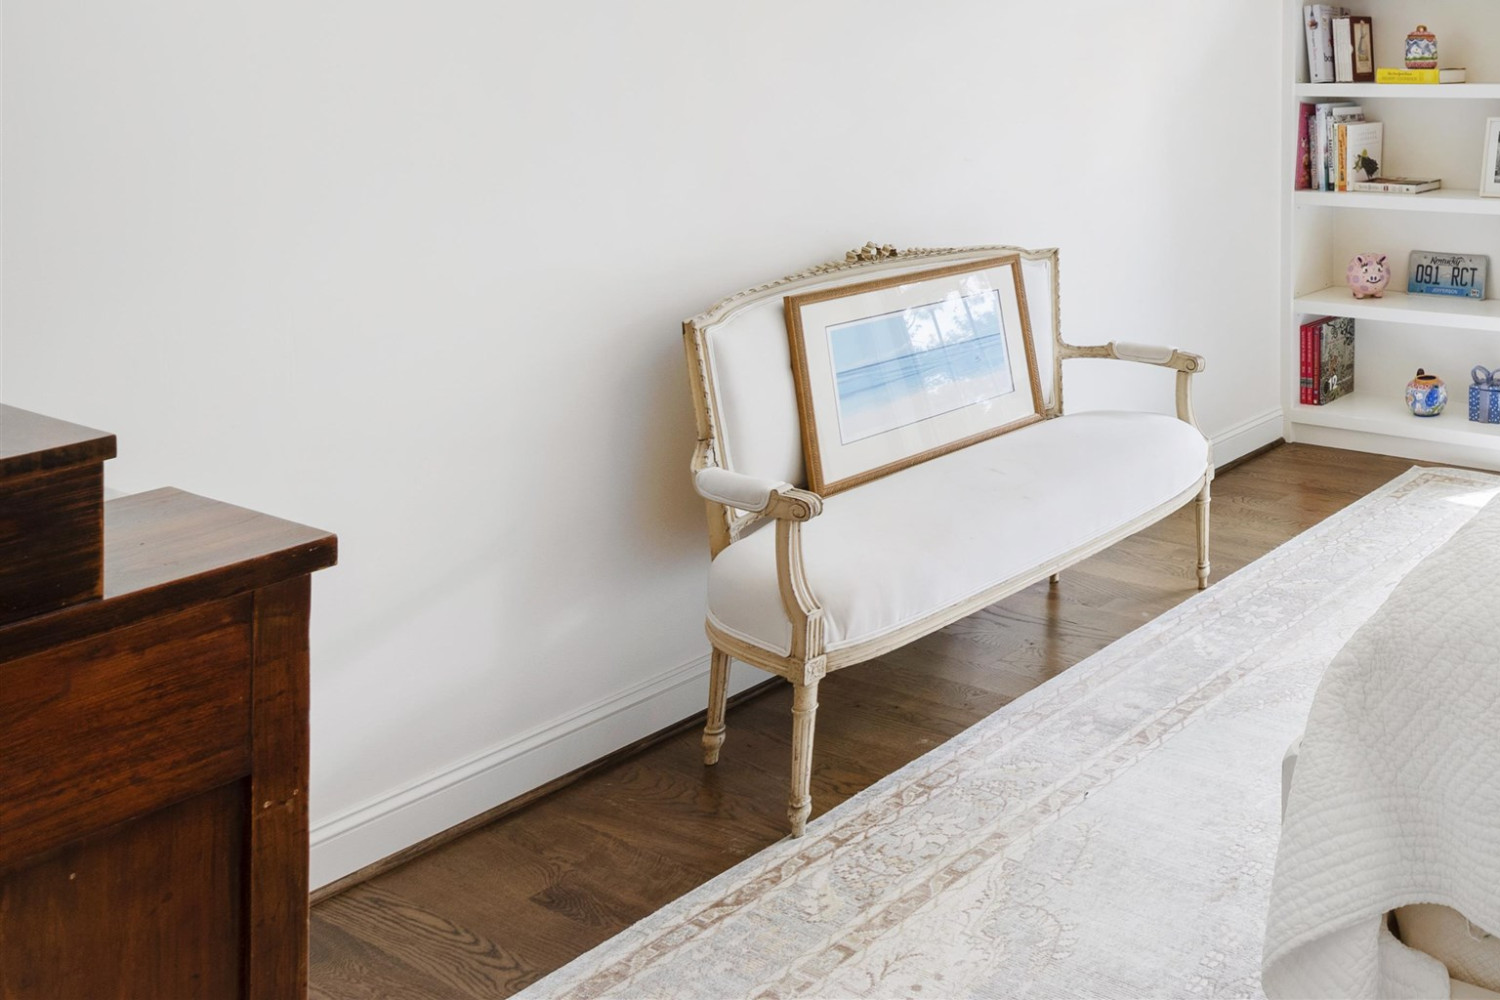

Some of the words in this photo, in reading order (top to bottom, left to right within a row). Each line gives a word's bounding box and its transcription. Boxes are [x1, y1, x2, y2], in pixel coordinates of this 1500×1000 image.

[1430, 256, 1462, 266] Kentucky
[1415, 264, 1440, 285] 091
[1451, 266, 1478, 287] RCT
